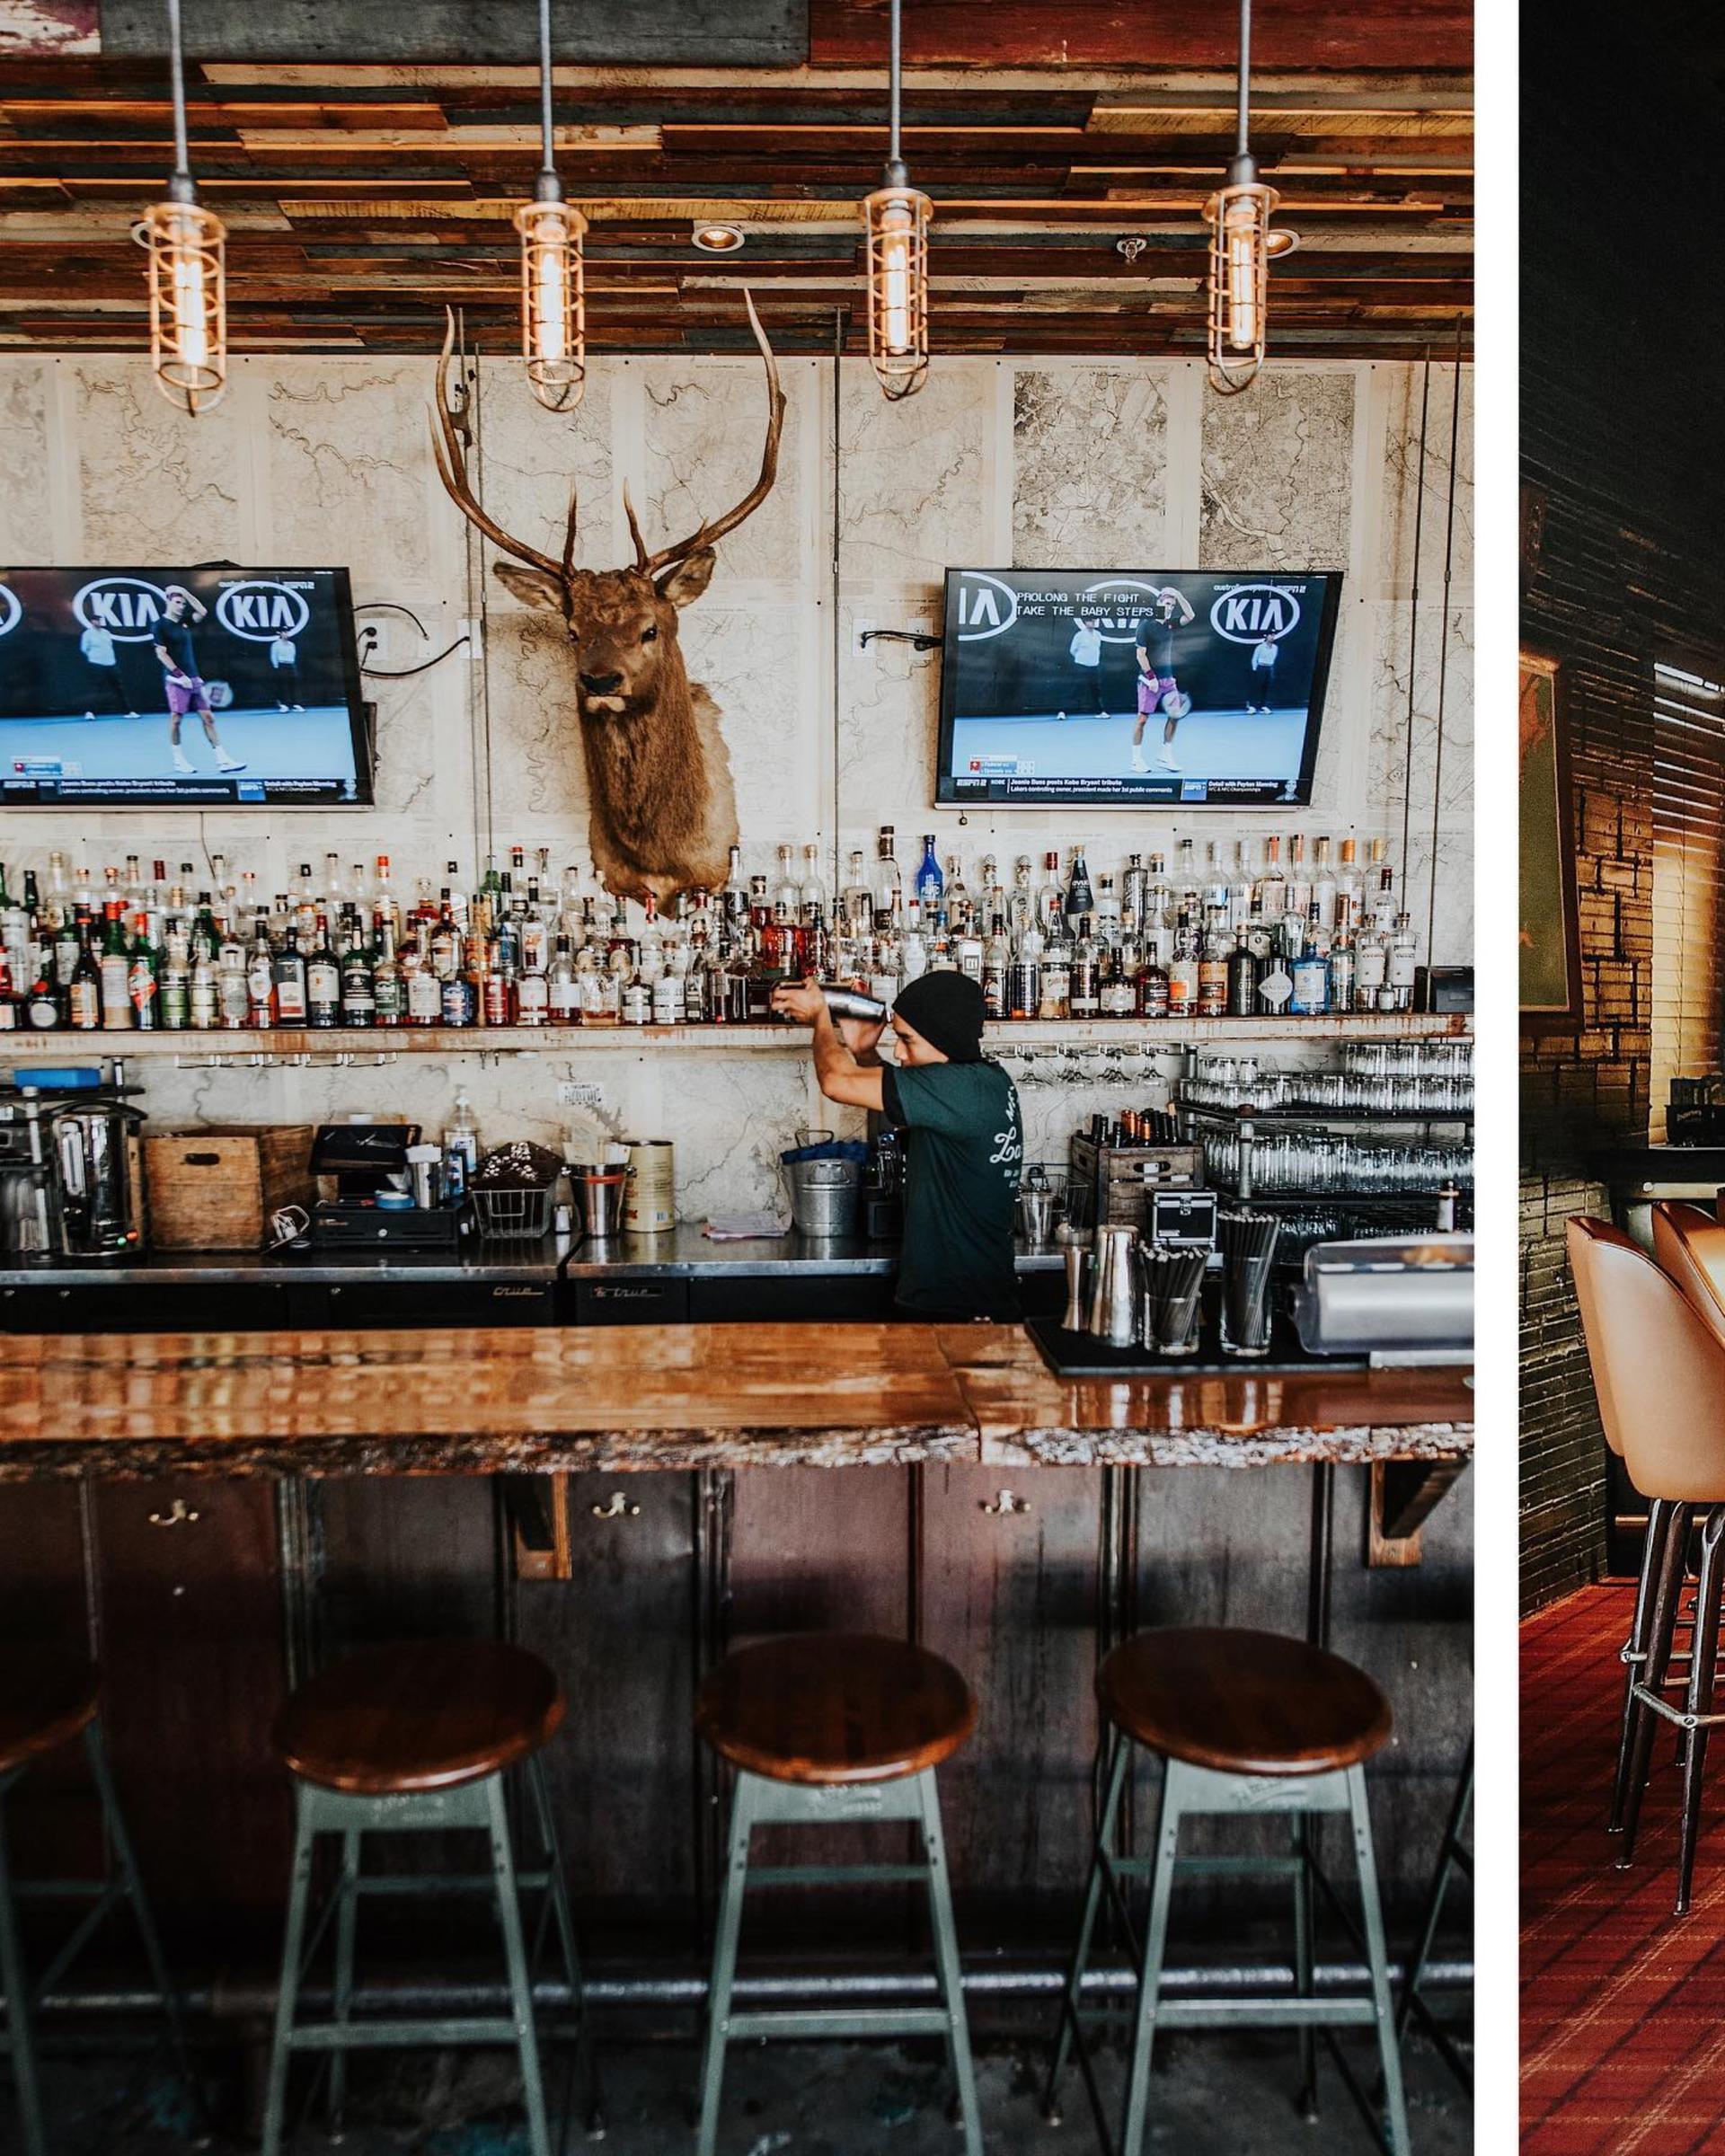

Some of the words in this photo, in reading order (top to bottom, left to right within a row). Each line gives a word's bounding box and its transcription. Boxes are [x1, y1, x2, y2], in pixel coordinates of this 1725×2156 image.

[90, 593, 160, 627] KIA
[231, 595, 296, 628] KIA
[1016, 592, 1068, 603] PROLONG
[1075, 592, 1097, 603] THE
[1016, 605, 1045, 616] TAKE
[1052, 605, 1075, 616] THE
[1081, 606, 1110, 616] BABY
[1225, 598, 1283, 631] KIA
